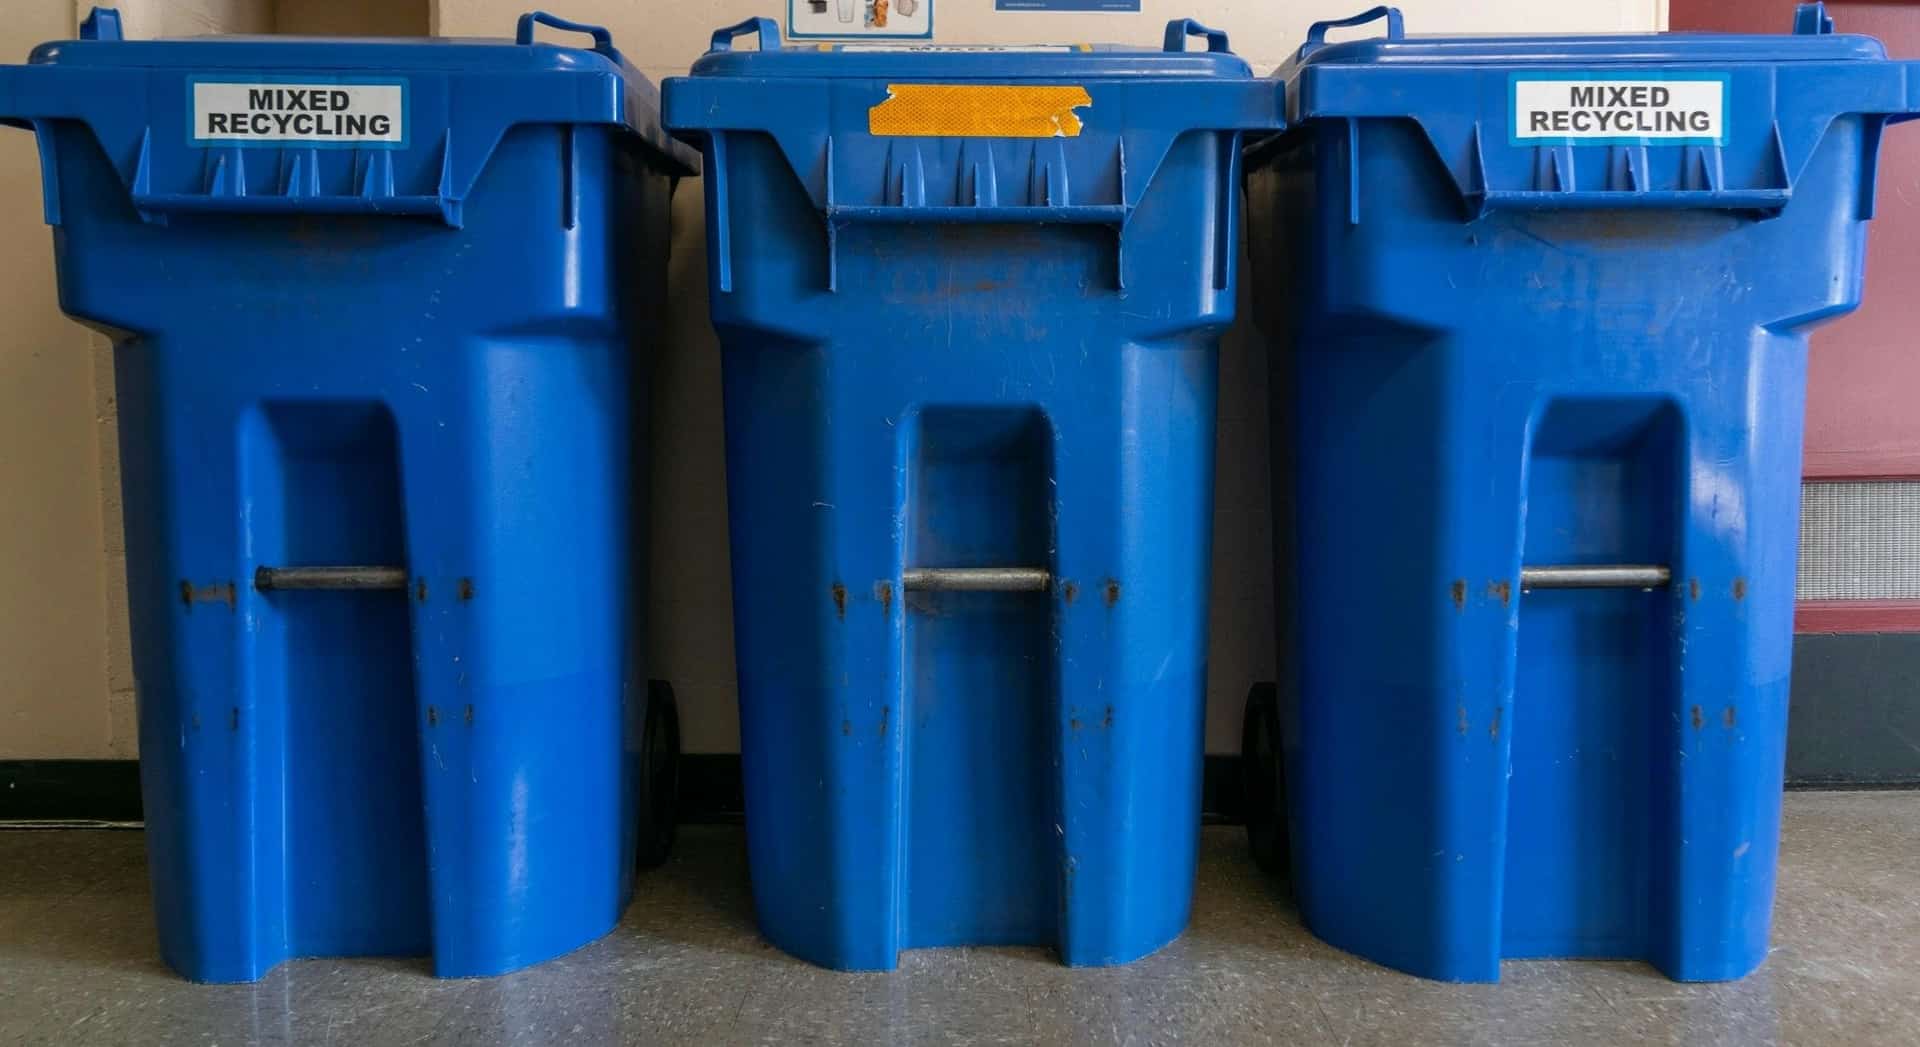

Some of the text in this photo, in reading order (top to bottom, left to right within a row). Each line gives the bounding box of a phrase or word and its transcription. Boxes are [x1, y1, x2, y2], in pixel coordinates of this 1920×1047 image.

[249, 89, 350, 111] MIXED
[1571, 86, 1670, 107] MIXED
[208, 113, 390, 135] RECYCLING
[1530, 111, 1710, 132] RECYCLING
